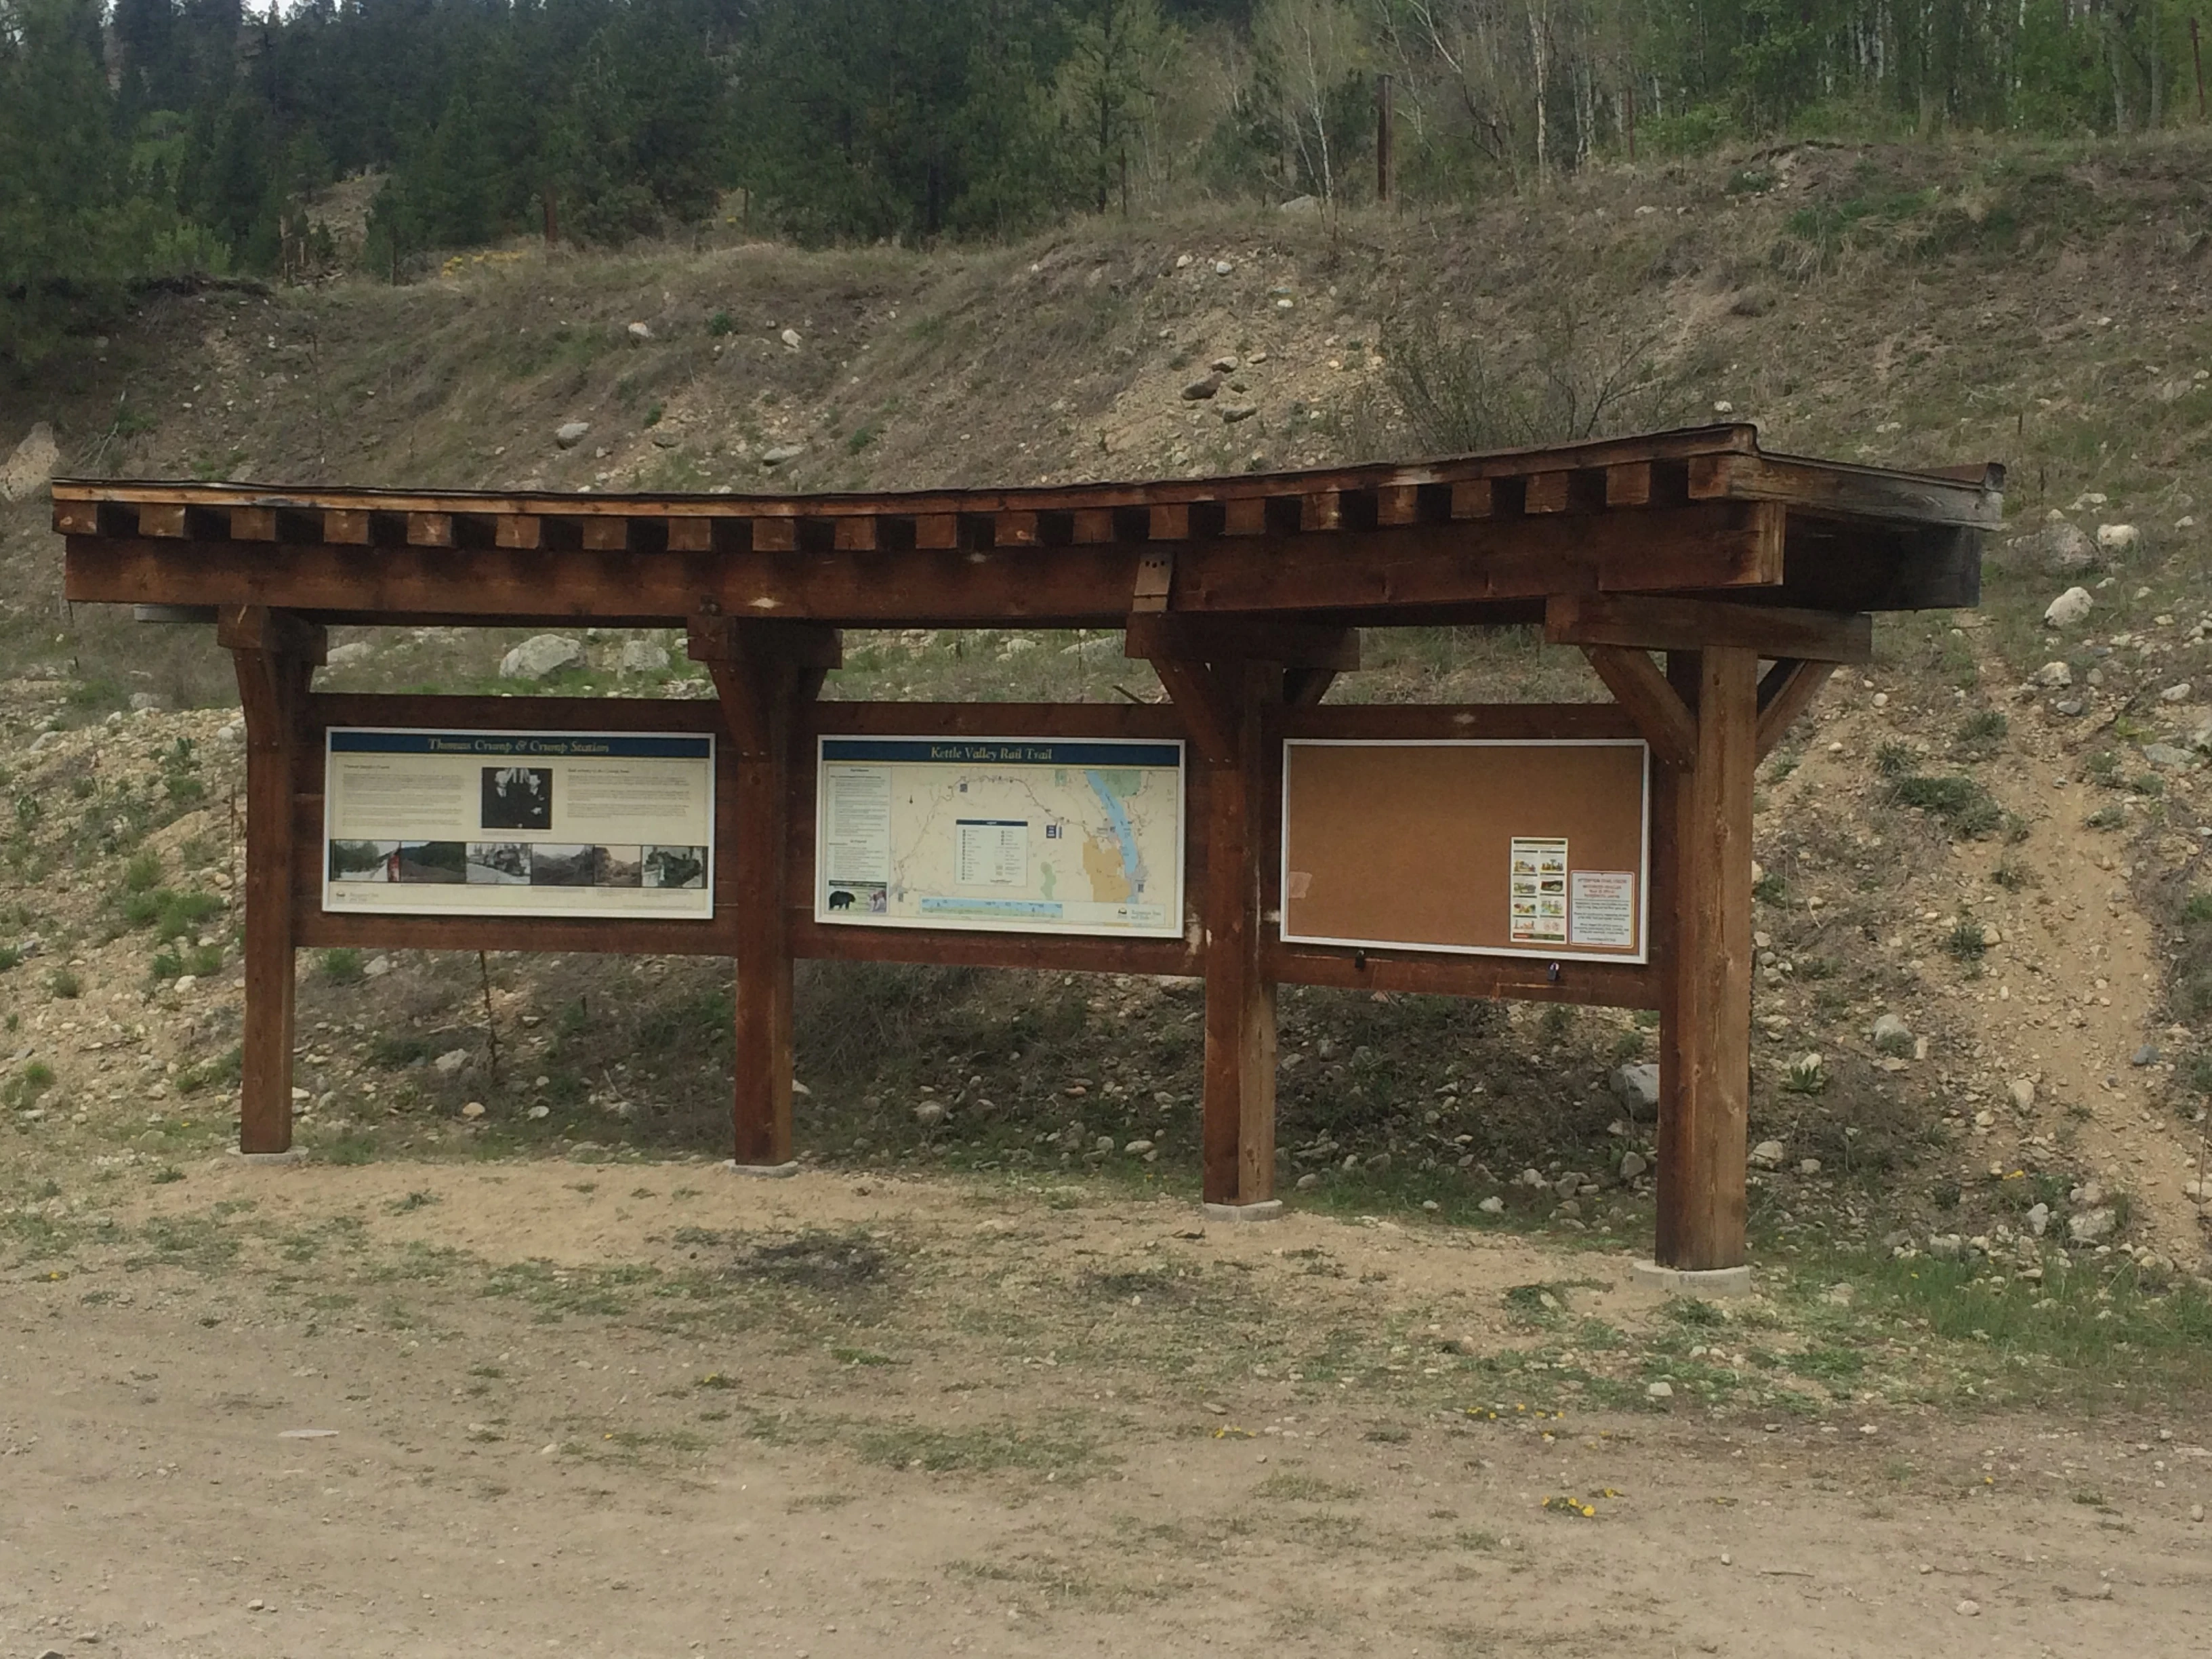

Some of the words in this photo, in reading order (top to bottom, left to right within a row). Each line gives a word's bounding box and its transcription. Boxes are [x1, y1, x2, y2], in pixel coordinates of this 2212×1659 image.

[474, 739, 512, 753] Crump
[515, 739, 528, 752] &
[530, 740, 569, 754] Crump
[571, 740, 609, 752] Station
[930, 746, 962, 759] Kettle
[964, 747, 997, 761] Valley
[1000, 747, 1022, 760] Rail
[1025, 747, 1052, 760] Trail
